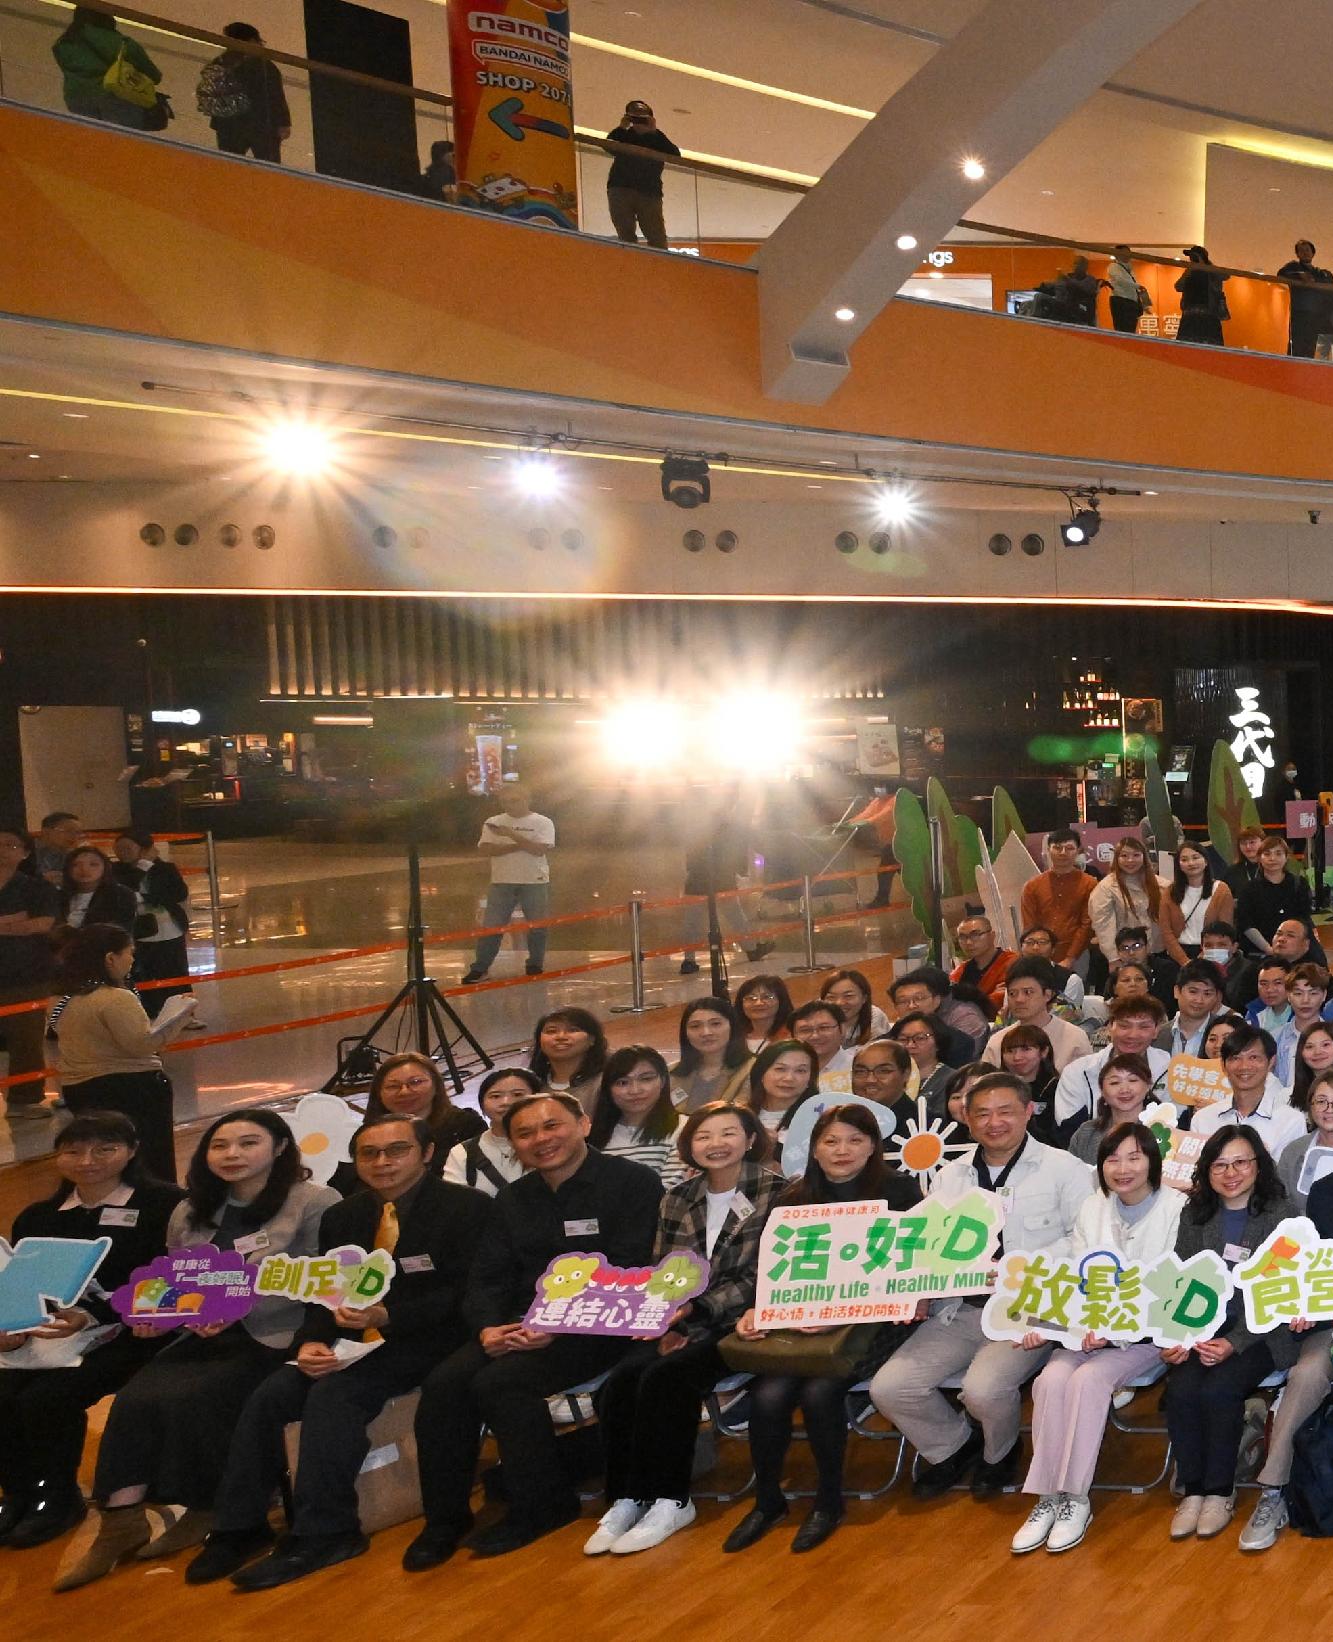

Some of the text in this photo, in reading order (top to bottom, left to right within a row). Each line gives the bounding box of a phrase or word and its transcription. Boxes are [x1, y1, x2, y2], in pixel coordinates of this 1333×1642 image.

[480, 46, 531, 63] BANDAI
[476, 71, 535, 92] SHOP
[172, 1259, 211, 1271] 健康從
[225, 1286, 251, 1297] 開始
[770, 1285, 835, 1305] Healthy
[839, 1280, 869, 1299] Life
[886, 1274, 949, 1295] Healthy
[530, 1297, 671, 1330] 連結心靈
